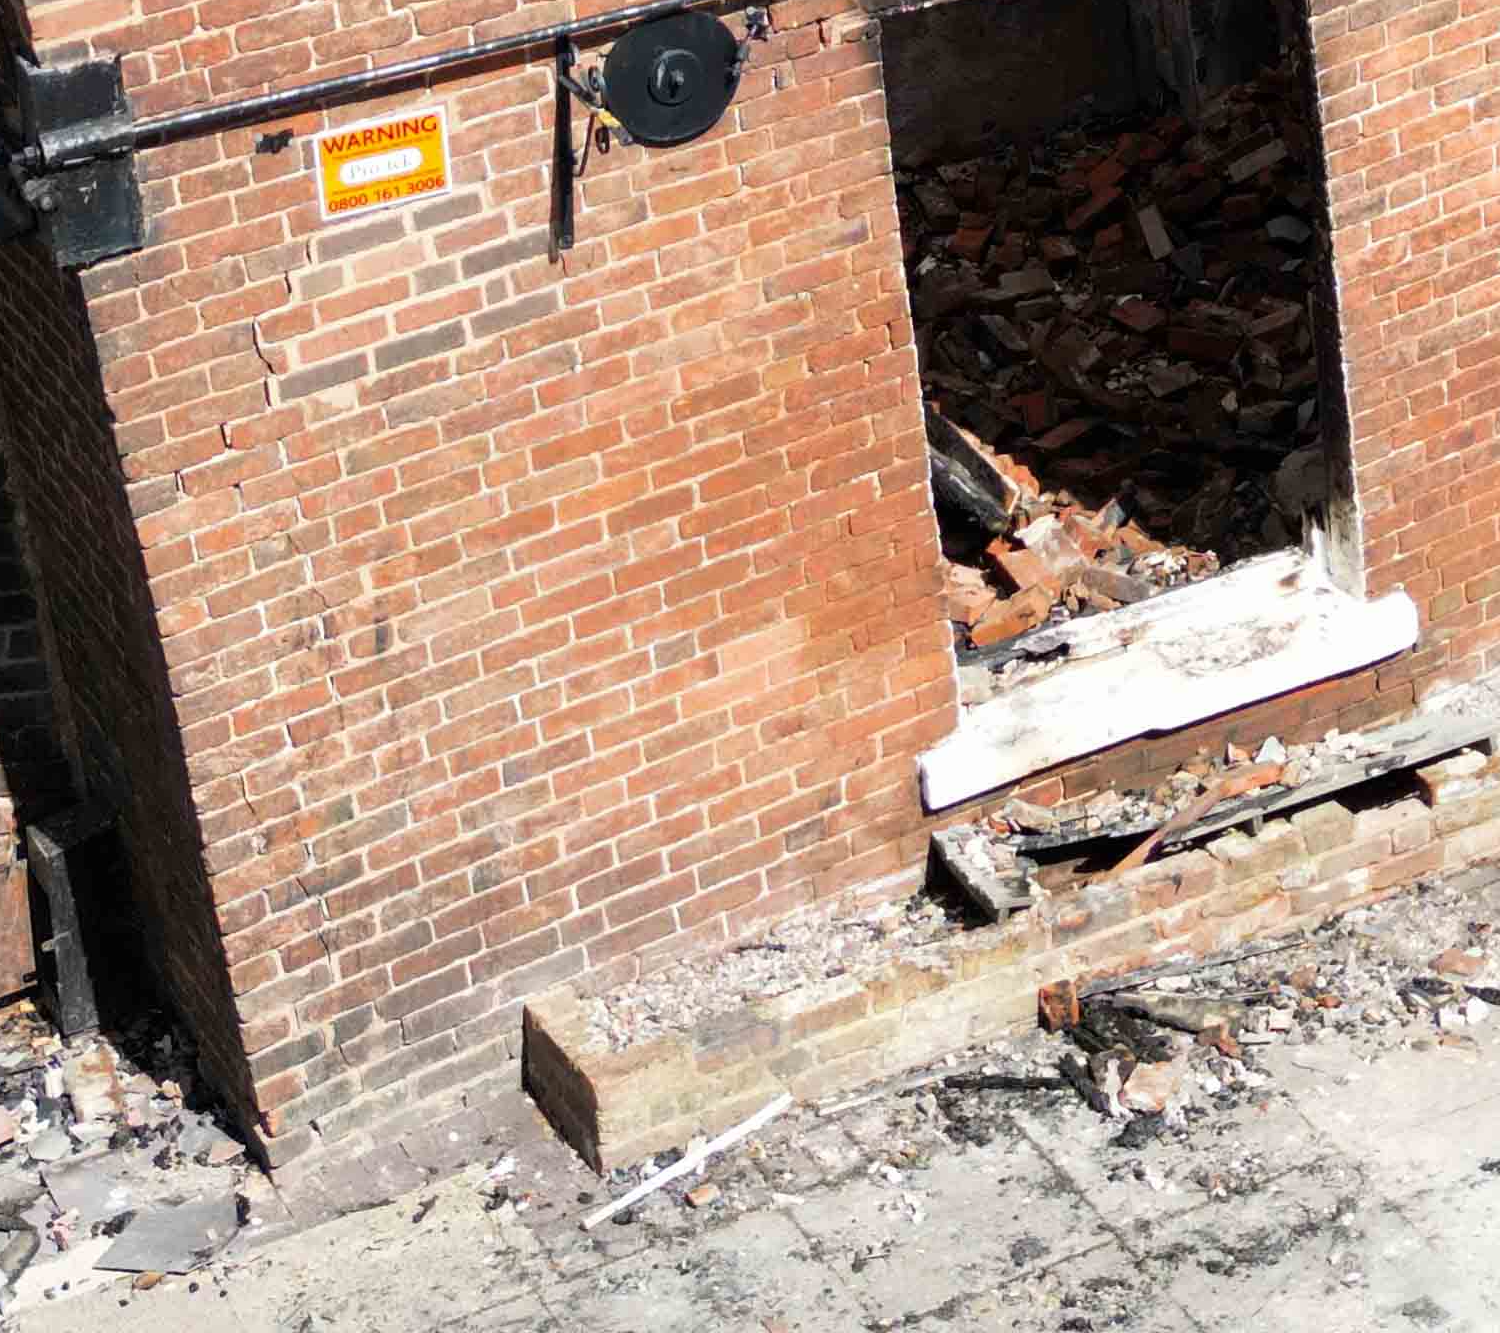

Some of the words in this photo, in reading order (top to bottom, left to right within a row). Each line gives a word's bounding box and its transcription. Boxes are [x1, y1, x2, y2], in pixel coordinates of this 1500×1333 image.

[323, 114, 437, 154] WARNING
[329, 193, 368, 212] 0800
[374, 186, 400, 201] 161
[408, 175, 445, 194] 3006
